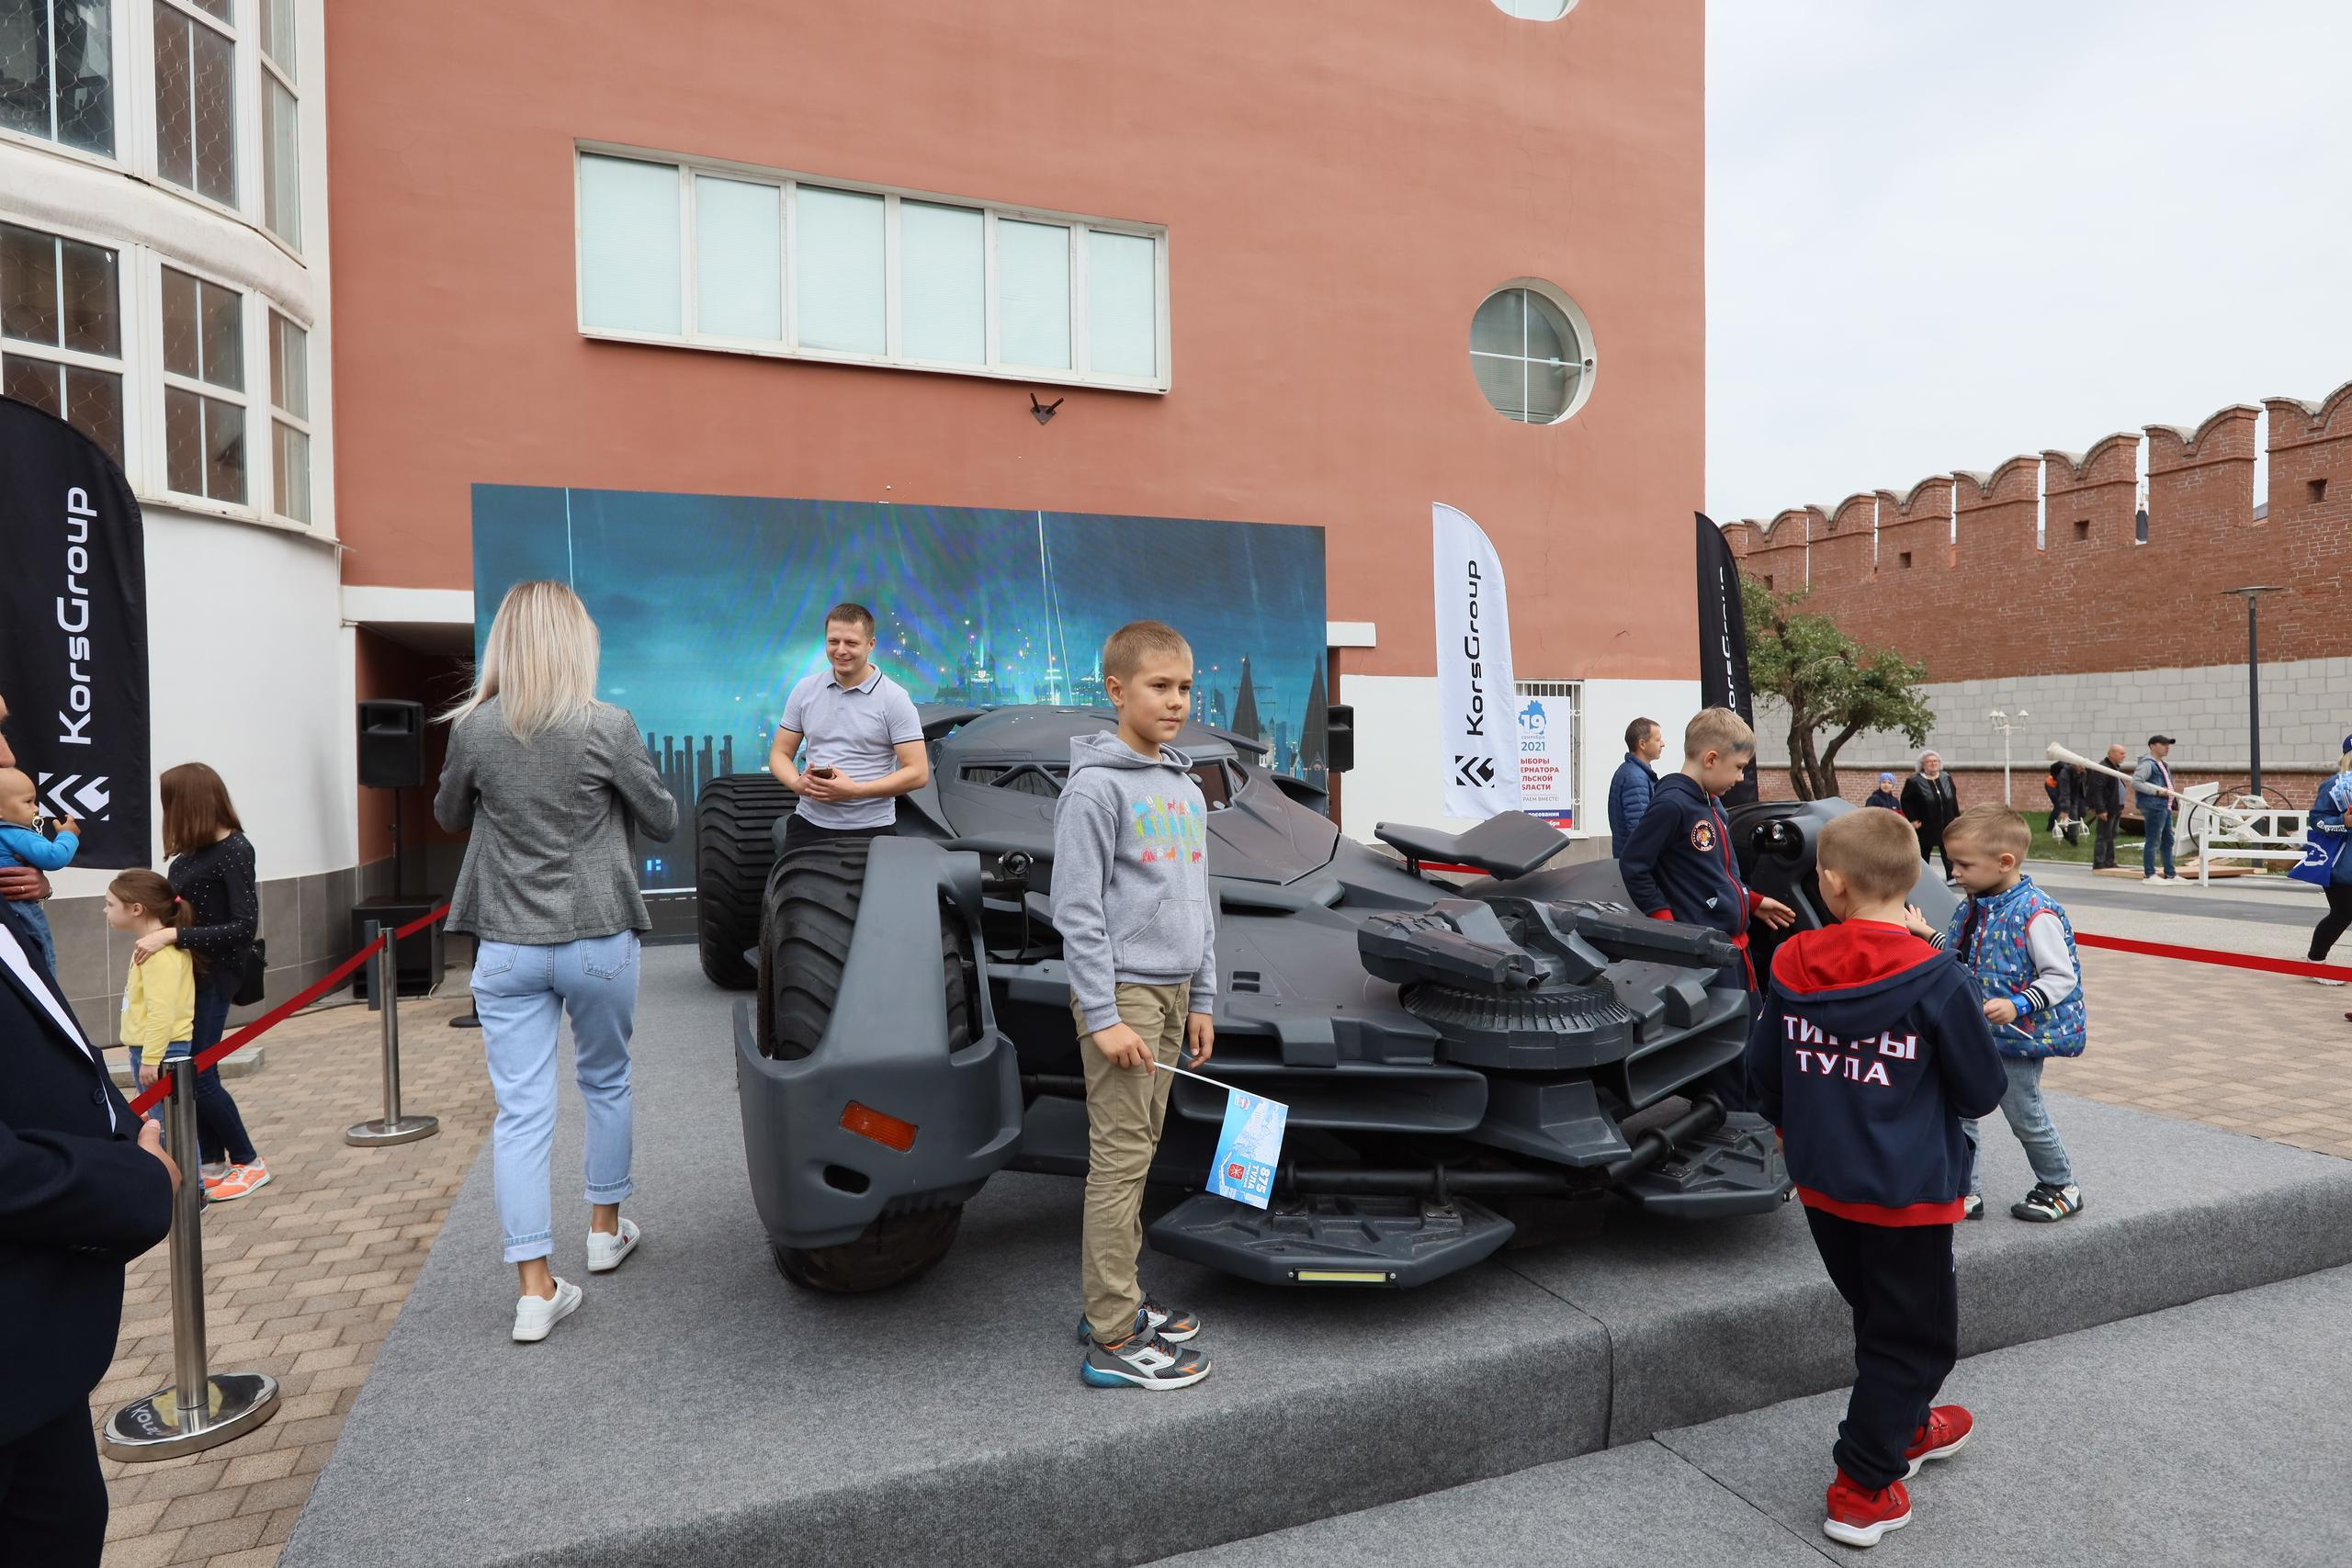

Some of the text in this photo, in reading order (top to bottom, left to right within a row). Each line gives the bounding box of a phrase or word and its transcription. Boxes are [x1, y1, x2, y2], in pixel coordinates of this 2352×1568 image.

[56, 486, 97, 745] KorsGroup
[1464, 559, 1484, 736] KorsGroup
[1521, 714, 1545, 734] 19
[1521, 741, 1545, 751] 2021
[1782, 1014, 1917, 1060] ТИЫ
[1794, 1049, 1892, 1088] ТУЛА
[1247, 1165, 1260, 1190] ТУЛА
[1255, 1167, 1271, 1194] 875
